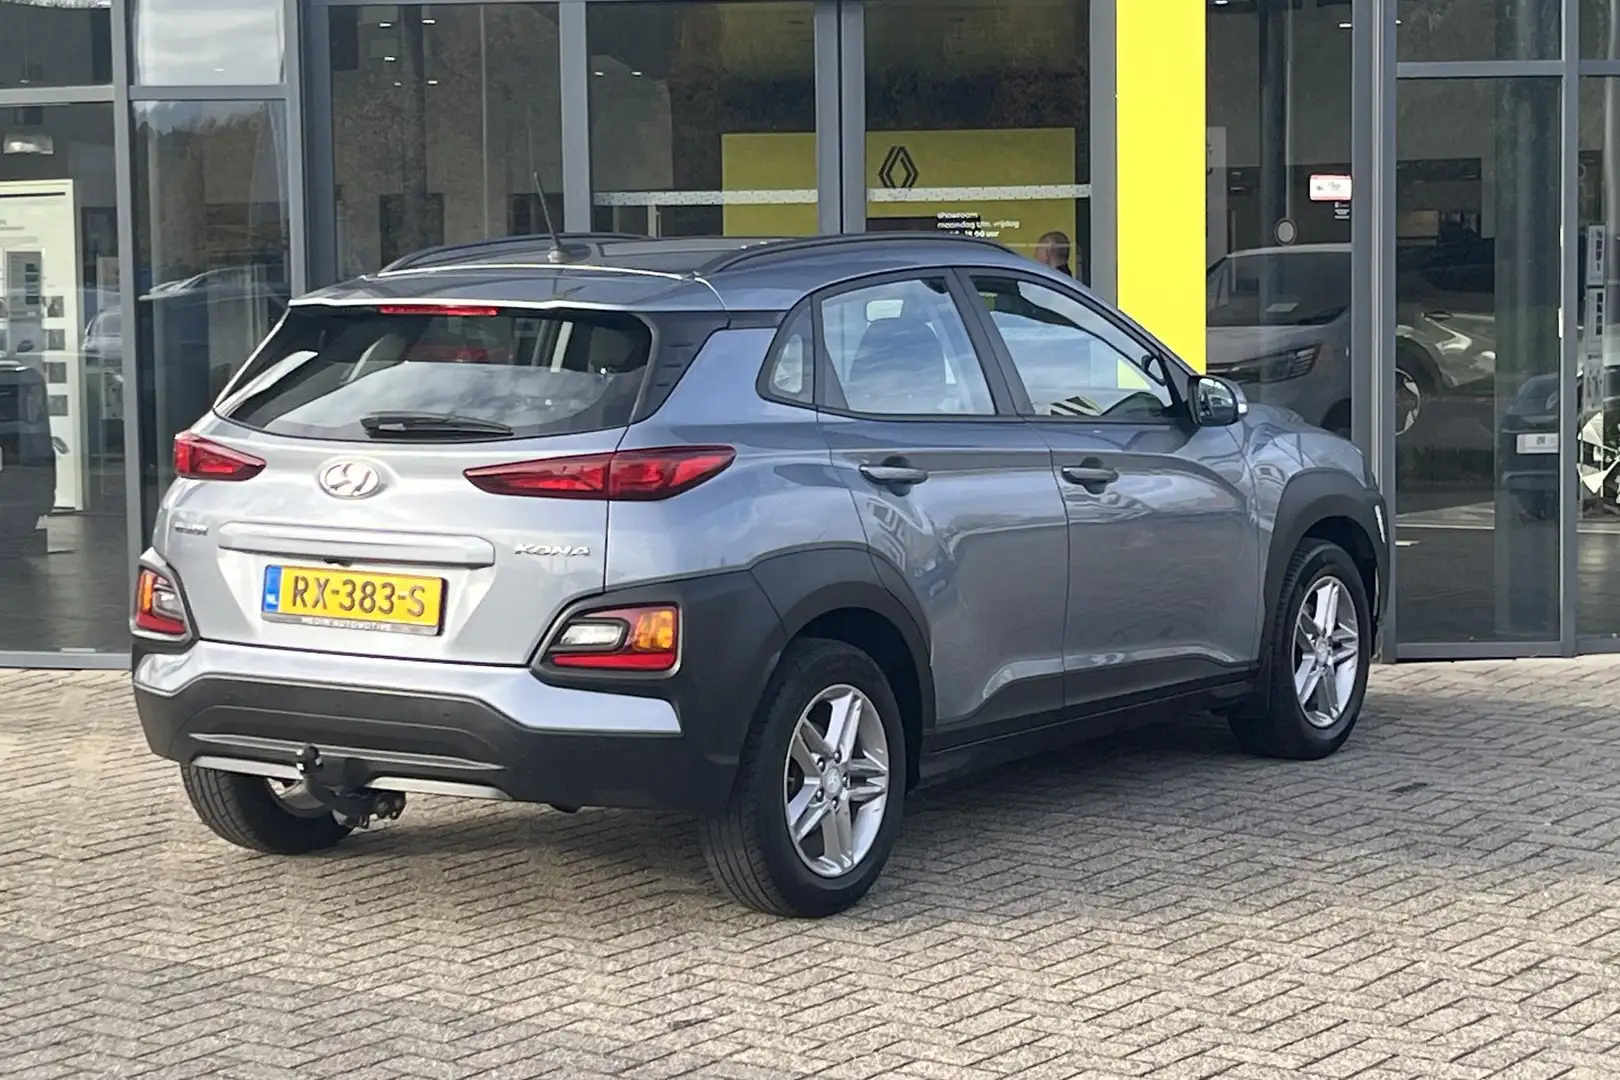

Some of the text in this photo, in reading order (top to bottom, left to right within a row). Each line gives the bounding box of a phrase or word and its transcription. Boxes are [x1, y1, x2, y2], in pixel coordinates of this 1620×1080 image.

[937, 221, 975, 229] maandag
[993, 221, 1020, 229] vrijdag
[514, 543, 591, 557] KONA
[292, 575, 426, 618] RX-383-S
[332, 619, 392, 632] AUTOMOTIVE
